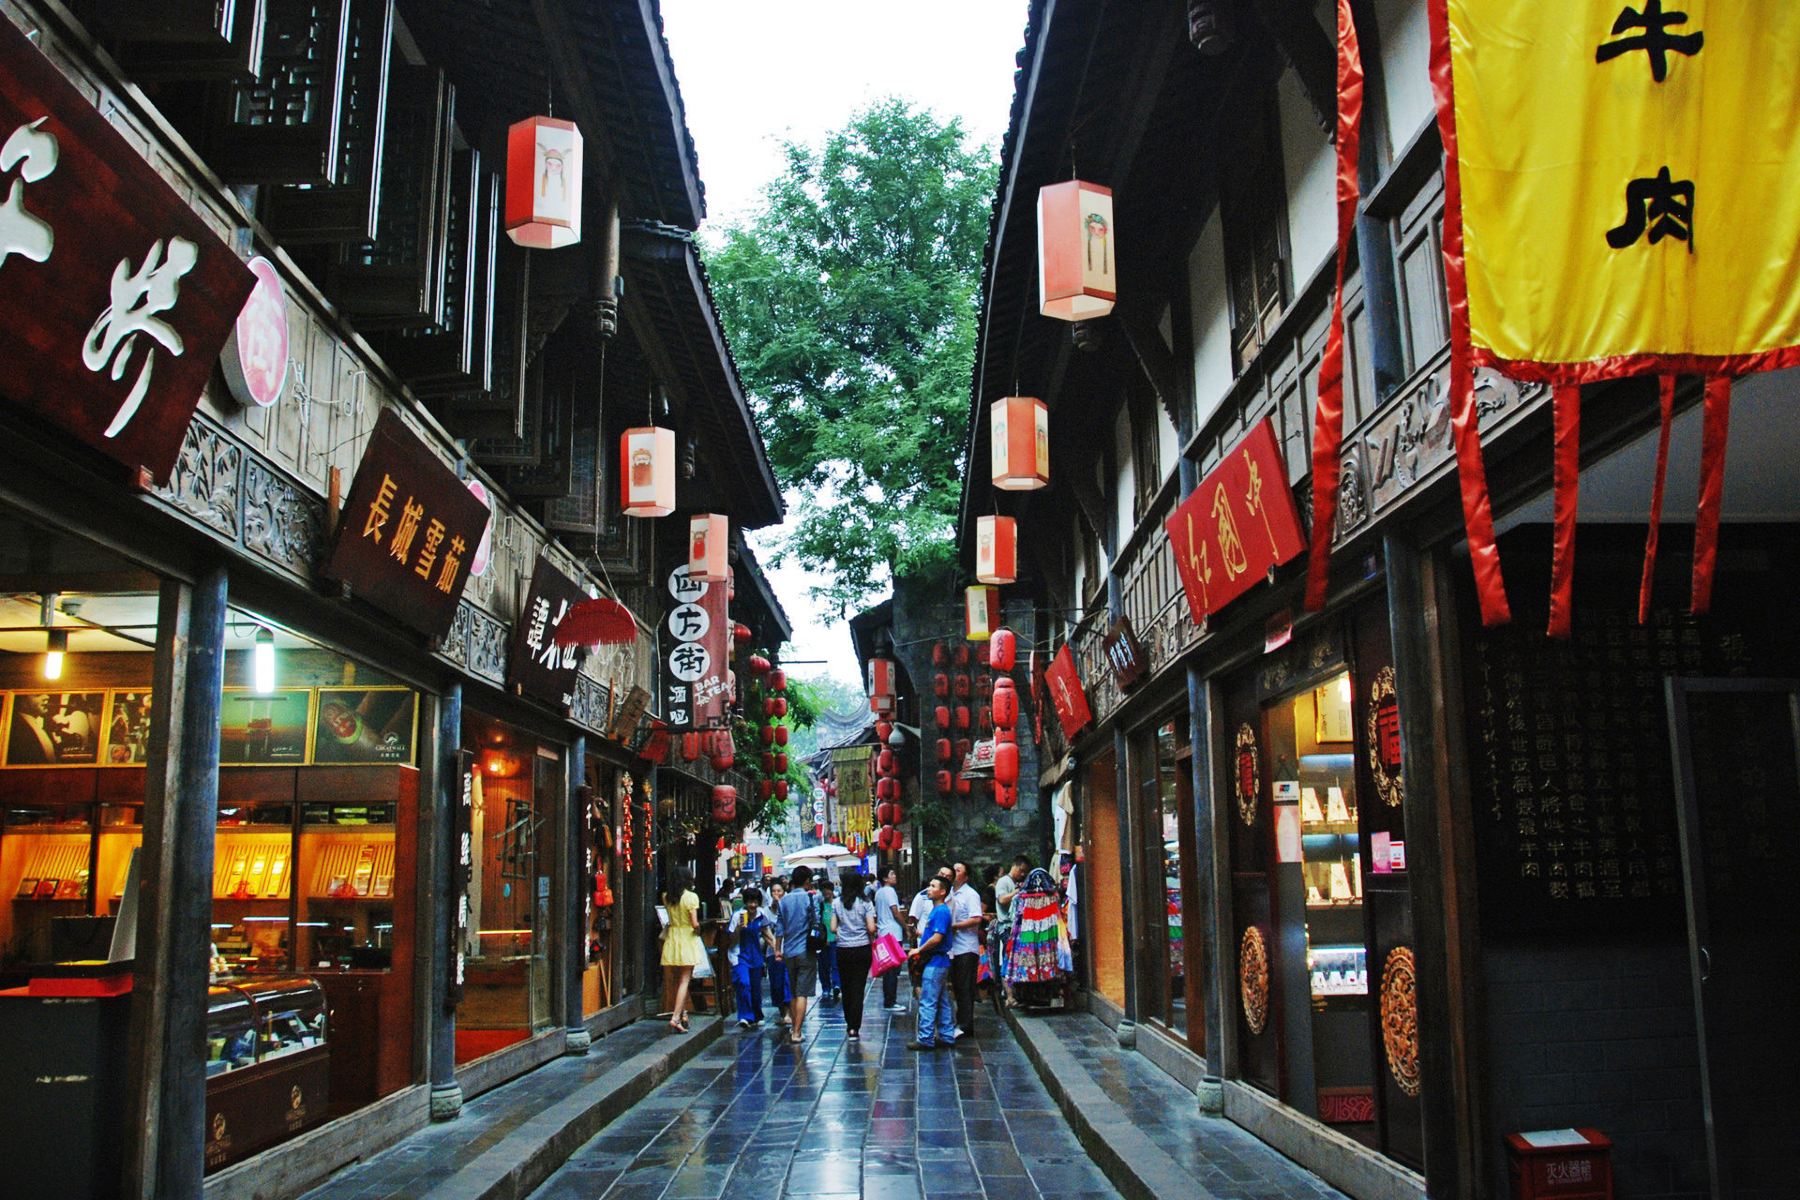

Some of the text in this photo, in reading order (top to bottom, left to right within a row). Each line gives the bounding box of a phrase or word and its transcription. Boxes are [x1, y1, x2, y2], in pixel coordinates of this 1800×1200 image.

[673, 573, 704, 674] 四方街
[694, 675, 719, 692] BAR
[706, 682, 730, 698] TEA
[668, 686, 689, 725] 酒吧
